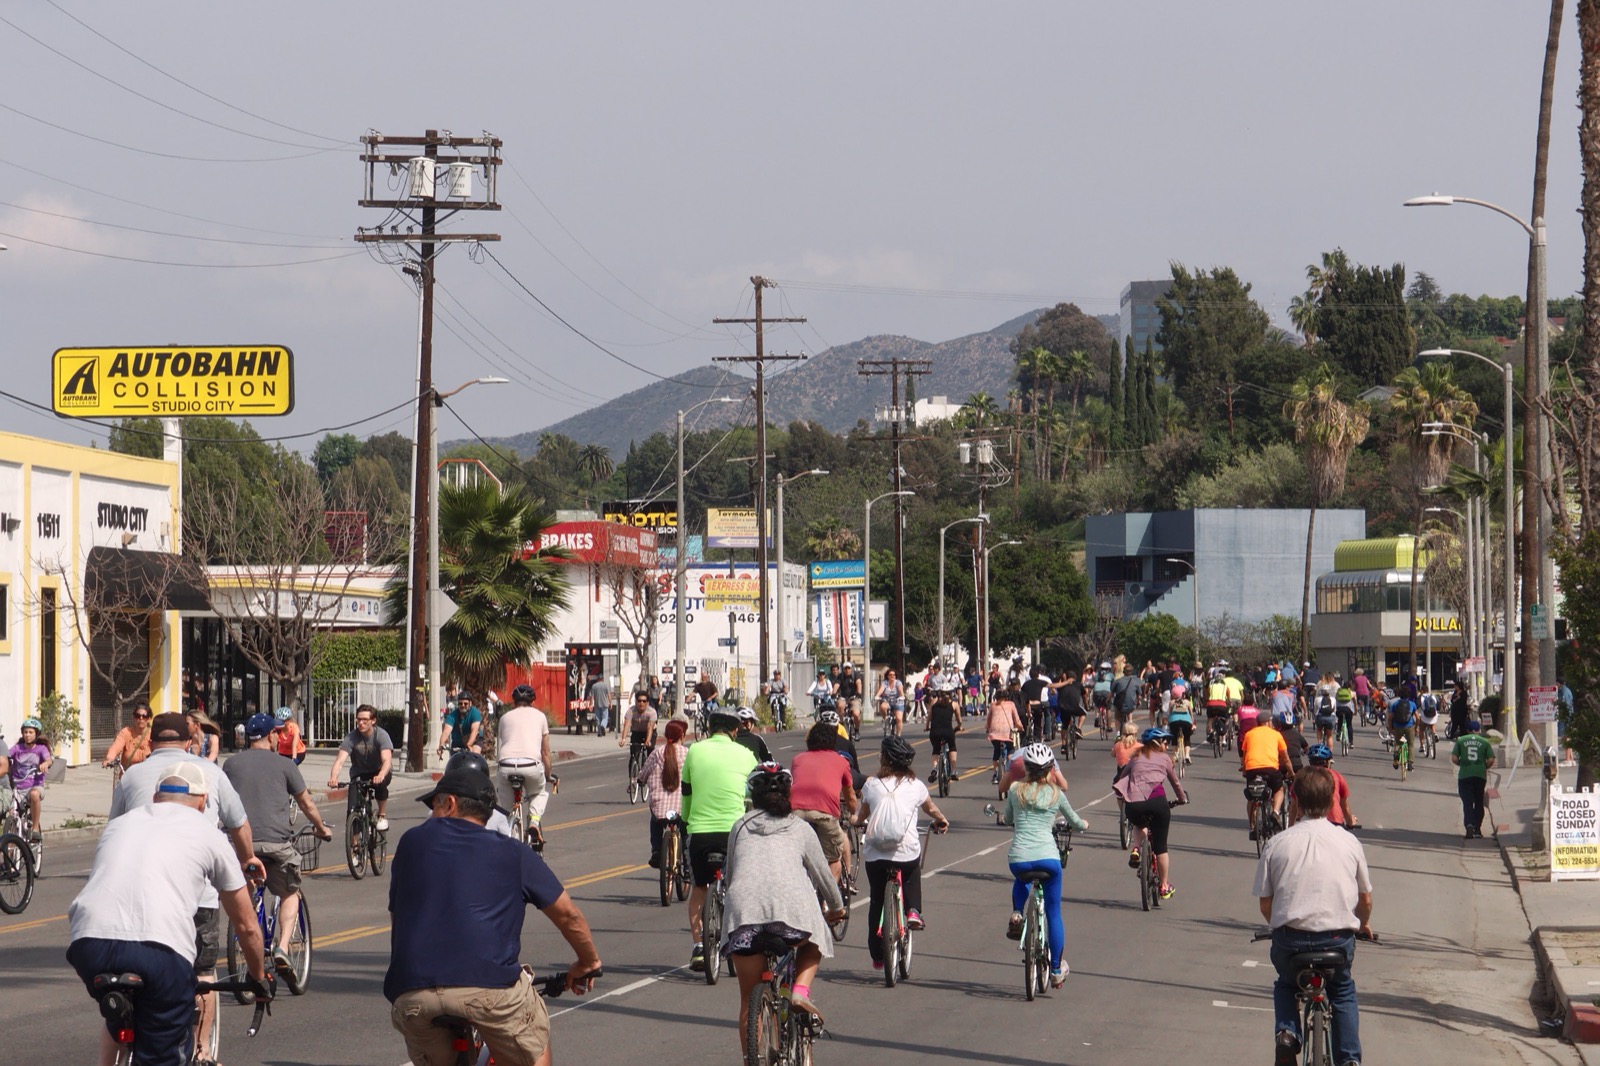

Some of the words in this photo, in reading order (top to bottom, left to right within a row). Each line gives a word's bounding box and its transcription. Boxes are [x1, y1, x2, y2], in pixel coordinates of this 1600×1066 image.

[107, 351, 281, 377] AUTOBAHN
[113, 381, 276, 398] COLLISION
[152, 401, 201, 412] STUDIO
[205, 400, 235, 411] CITY
[97, 502, 128, 531] STUDIO
[129, 507, 148, 532] CITY
[37, 512, 60, 539] 11511
[541, 533, 594, 550] BRAKES
[711, 581, 745, 591] EXPRESS
[708, 594, 725, 602] AUTO
[850, 602, 858, 646] FINANCE
[1467, 746, 1478, 761] 5
[1562, 800, 1590, 809] ROAD
[1556, 810, 1596, 819] CLOSED
[1556, 820, 1596, 829] SUNDAY
[1556, 847, 1598, 855] INFORMATION
